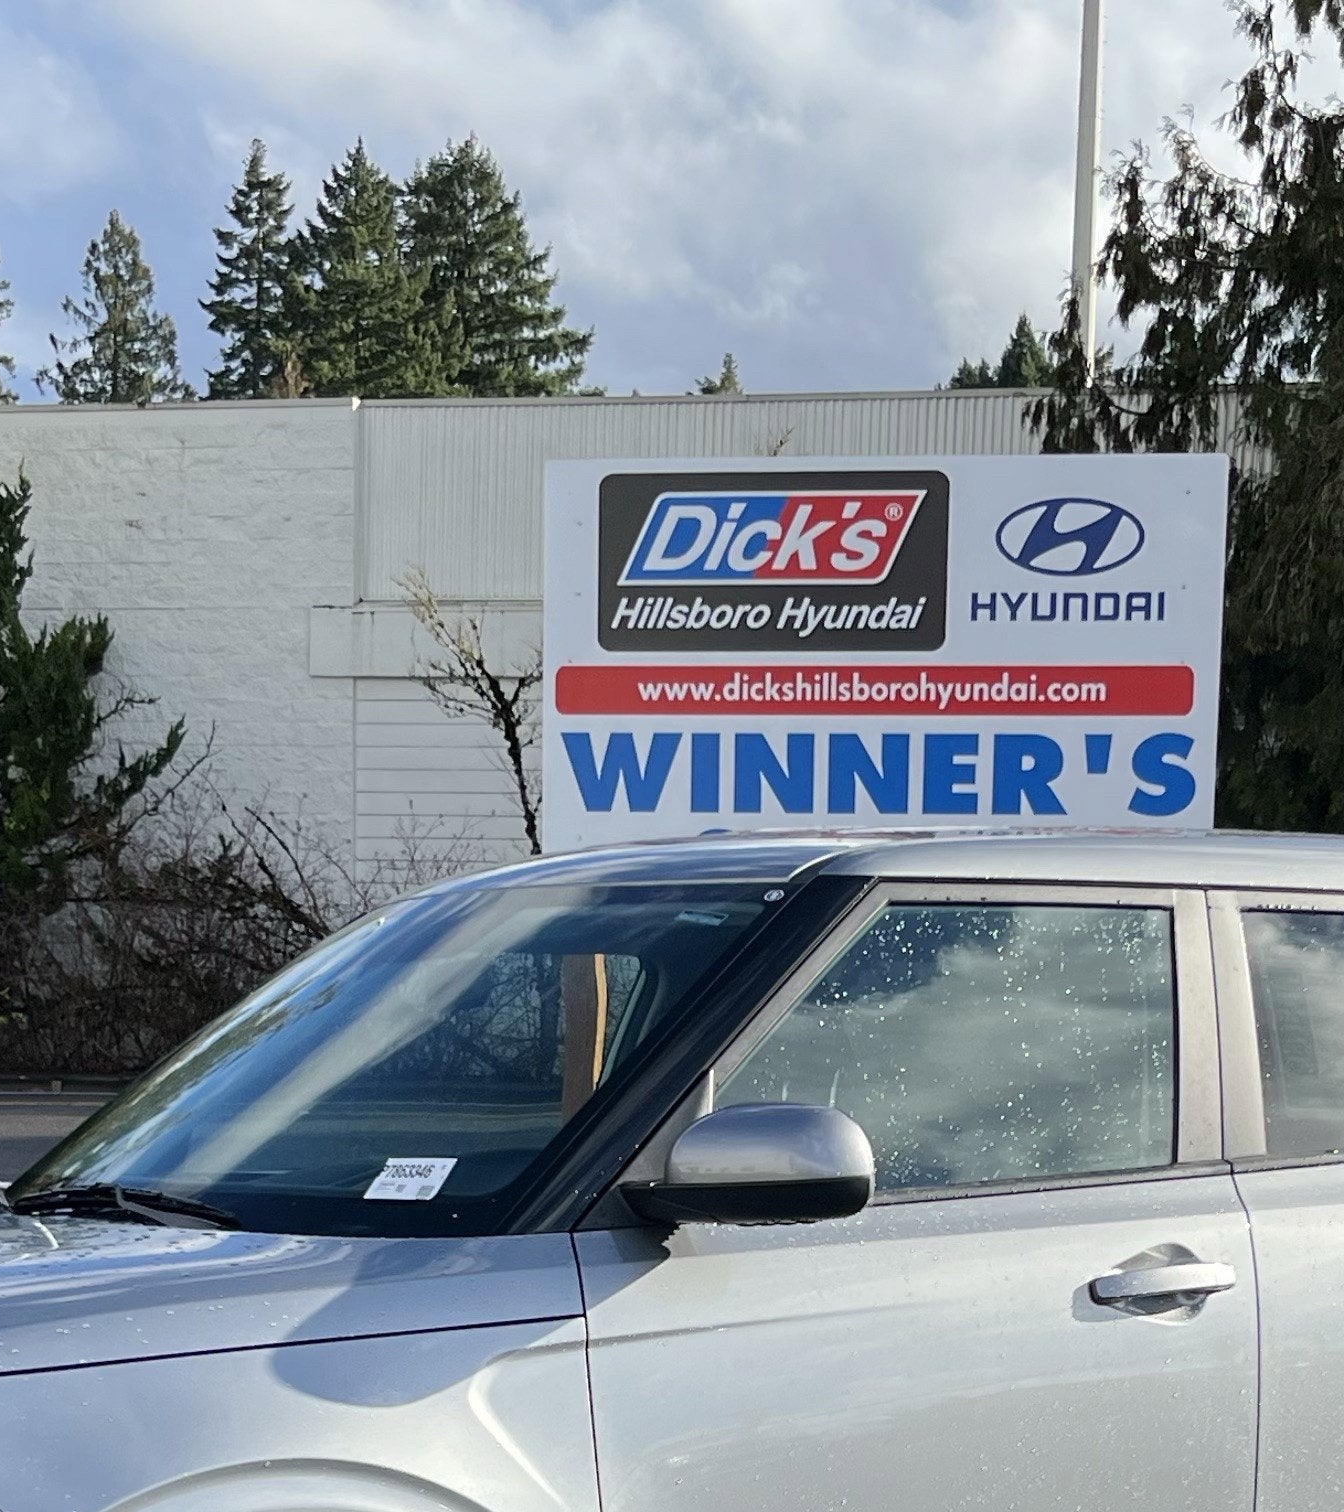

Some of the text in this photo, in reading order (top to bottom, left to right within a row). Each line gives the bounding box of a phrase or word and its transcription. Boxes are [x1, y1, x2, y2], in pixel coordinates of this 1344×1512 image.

[642, 502, 887, 572] Dick's
[611, 597, 927, 638] Hillsboro Hyundai
[971, 592, 1165, 622] HYUNDAI
[637, 671, 1108, 710] www.dickshillsborohyundai.com
[560, 732, 1197, 817] WINNER'S
